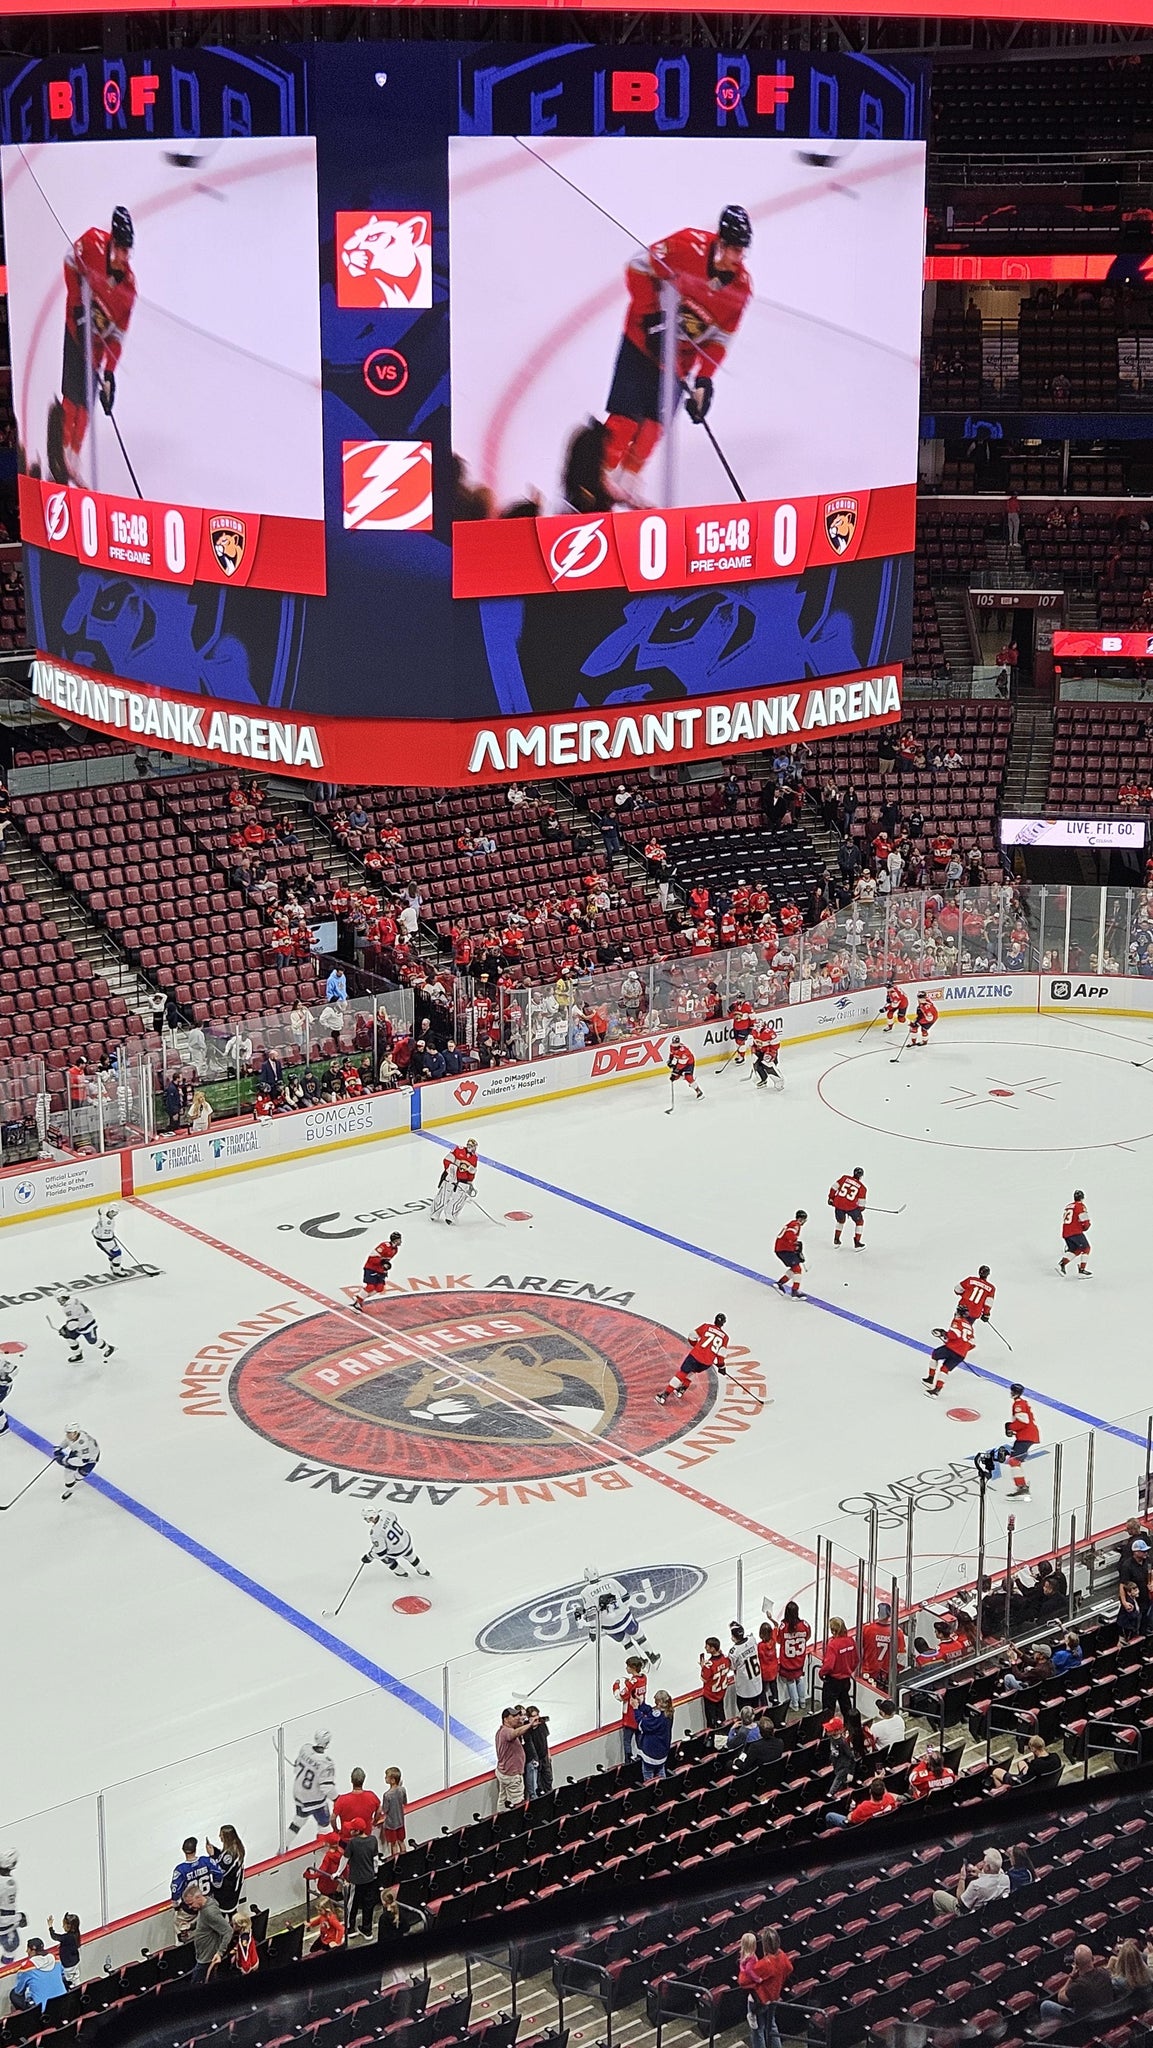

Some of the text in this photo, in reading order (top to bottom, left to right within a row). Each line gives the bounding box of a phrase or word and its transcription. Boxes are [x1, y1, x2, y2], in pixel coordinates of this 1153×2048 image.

[49, 81, 73, 119] B
[130, 75, 159, 116] F
[612, 71, 660, 112] B
[756, 75, 794, 113] F
[375, 365, 397, 380] VS
[80, 495, 98, 558] 0
[110, 511, 149, 548] 15:48
[696, 518, 750, 555] 15:48
[773, 504, 797, 567] 0
[164, 509, 186, 574] 0
[639, 515, 667, 581] 0
[109, 546, 151, 566] PRE-GAME
[690, 555, 752, 573] PRE-GAME
[976, 595, 994, 606] 105
[1037, 596, 1056, 606] 107
[1102, 637, 1123, 652] B
[28, 660, 325, 769] AMERANT BANK ARENA
[467, 675, 902, 773] AMERANT BANK ARENA
[1096, 823, 1114, 835] FIT.
[1117, 824, 1135, 836] GO.
[945, 984, 1013, 1000] AMAZING
[591, 1036, 667, 1077] DEX
[482, 1077, 546, 1097] Children's Hospital
[490, 1070, 536, 1086] Joe DiMaggio
[305, 1102, 374, 1127] COMCAST
[226, 1130, 258, 1146] TROPICAL
[305, 1115, 374, 1141] BUSINESS
[168, 1143, 200, 1159] TROPICAL
[45, 1170, 88, 1183] Official Luxury
[45, 1181, 67, 1190] Vehicle
[45, 1183, 94, 1198] Florida Panthers
[838, 1182, 859, 1201] 53
[968, 1286, 985, 1304] 11
[178, 1300, 306, 1417] AMERANT
[484, 1274, 637, 1307] ARENA
[315, 1320, 525, 1386] PANTHERS
[700, 1331, 723, 1354] 79
[284, 1462, 462, 1506] ARENA
[475, 1469, 635, 1507] BANK
[838, 1462, 978, 1515] OMEGA
[386, 1520, 404, 1546] 90
[785, 1637, 806, 1658] 63
[876, 1641, 889, 1661] 7
[743, 1655, 760, 1680] 16
[711, 1668, 729, 1693] 22
[296, 1762, 315, 1790] 78
